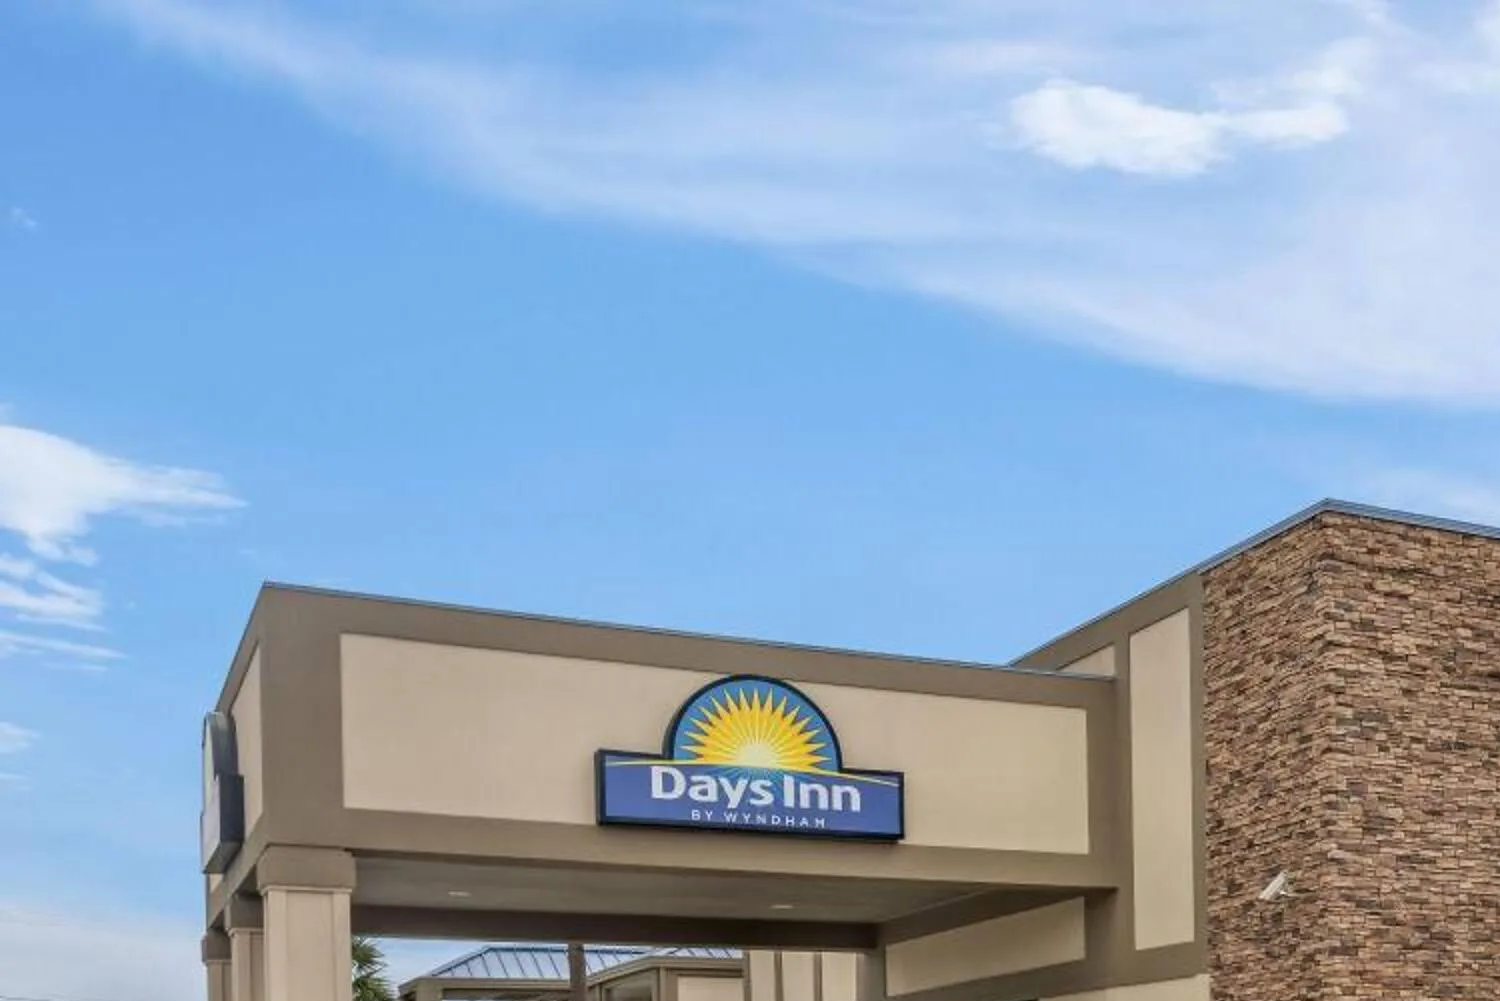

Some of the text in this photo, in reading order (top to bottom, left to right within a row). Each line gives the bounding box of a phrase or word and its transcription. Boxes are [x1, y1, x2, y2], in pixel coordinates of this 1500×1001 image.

[650, 765, 861, 813] Days Inn
[690, 809, 826, 829] BY WYNDHAM
